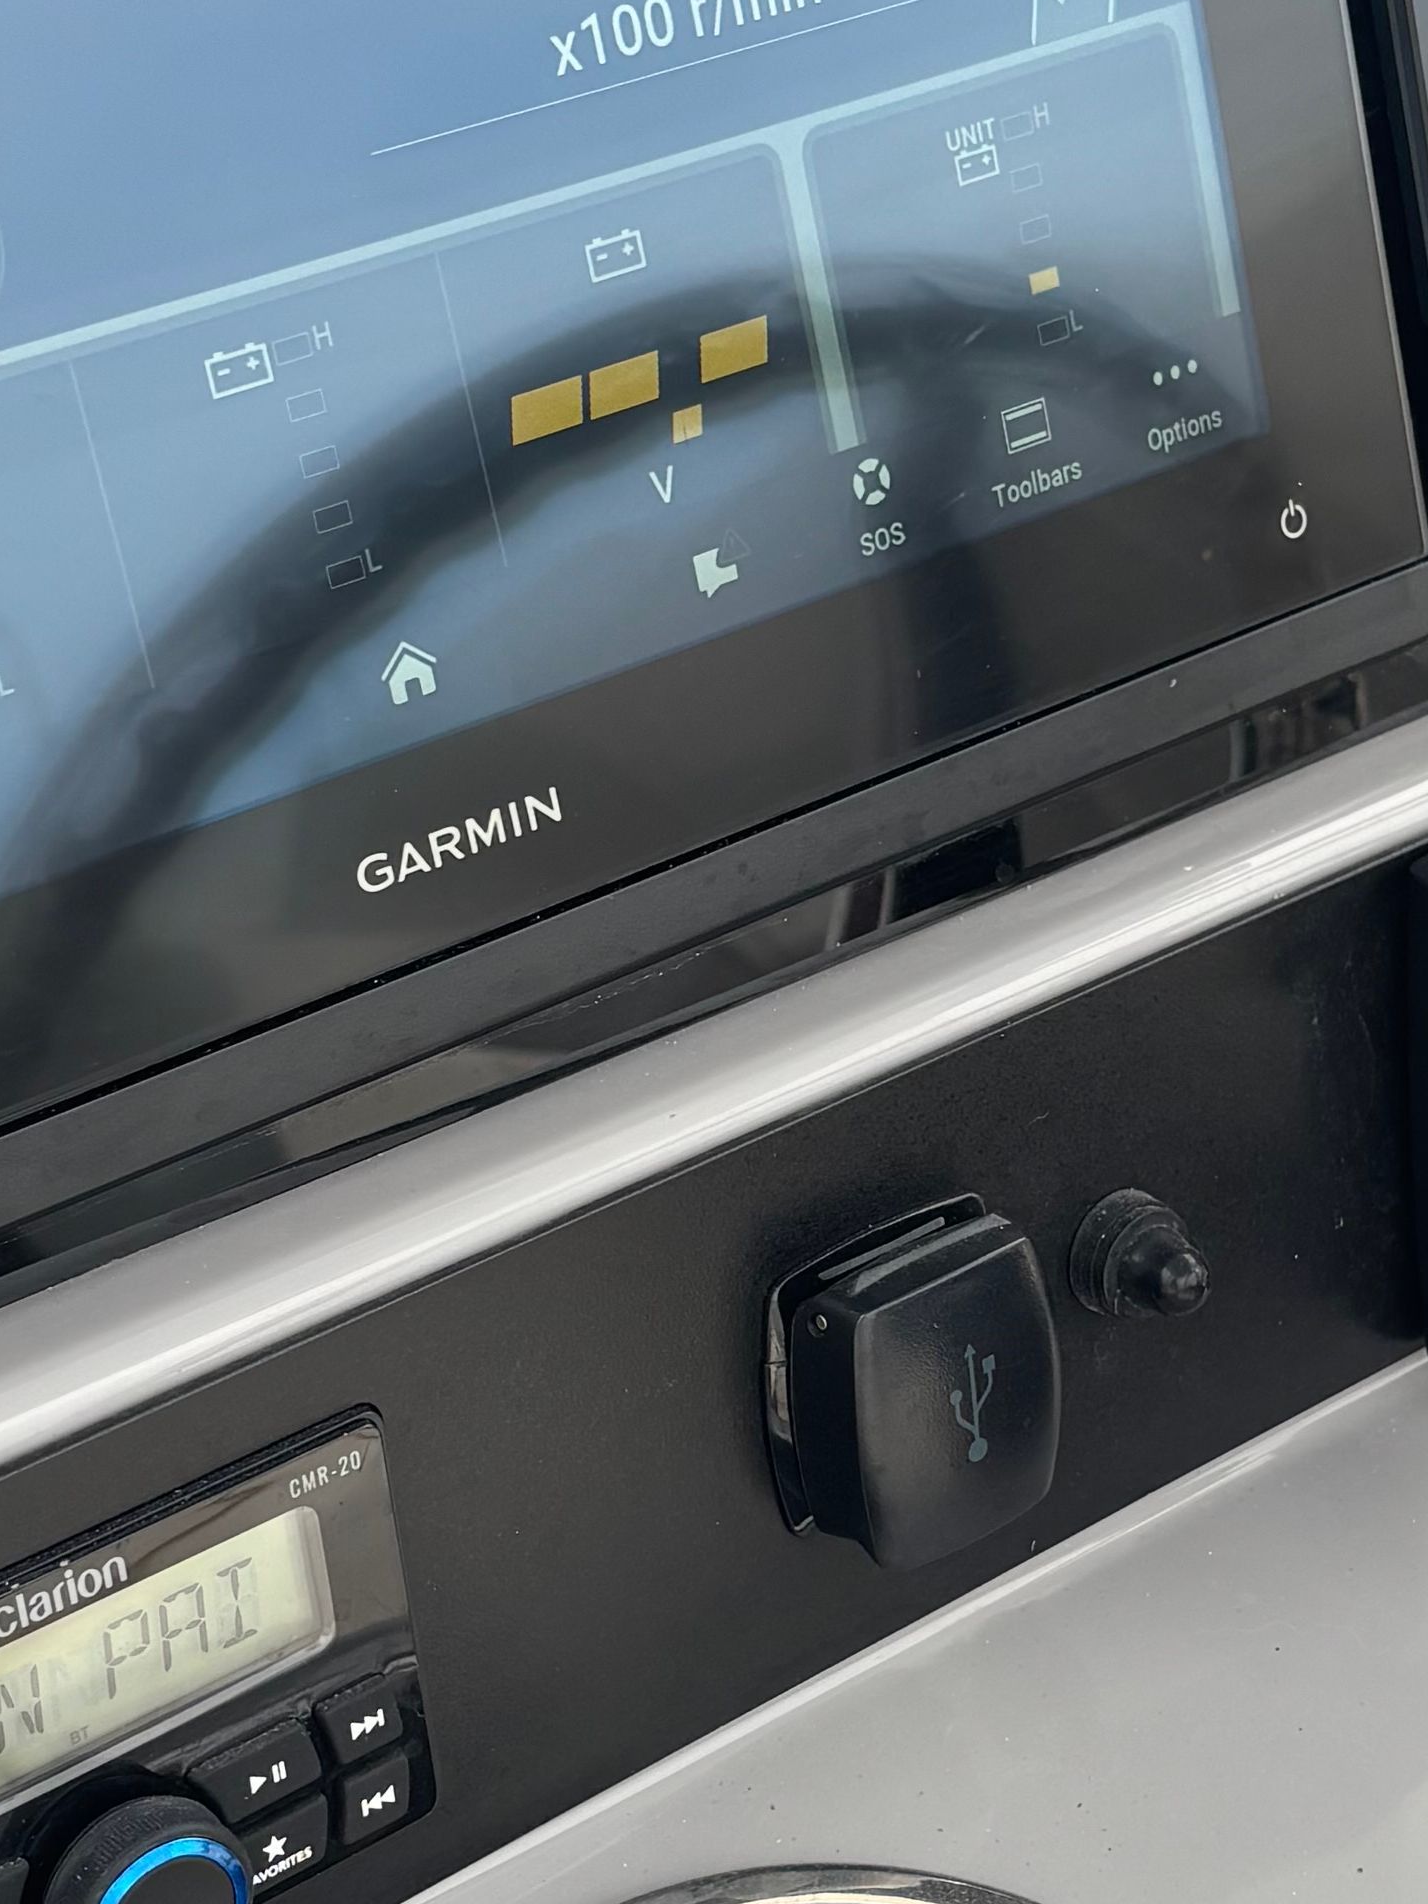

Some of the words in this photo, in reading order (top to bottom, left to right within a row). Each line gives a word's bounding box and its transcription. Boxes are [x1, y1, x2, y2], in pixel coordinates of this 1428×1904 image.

[945, 117, 997, 153] UNIT
[1033, 103, 1051, 130] H
[312, 322, 334, 352] H
[1147, 408, 1223, 453] Options
[649, 465, 674, 504] V
[992, 458, 1083, 509] Toolbars
[860, 522, 907, 558] SOS
[364, 548, 383, 575] L
[356, 785, 563, 894] GARMIN
[288, 1449, 363, 1501] CMR-20
[252, 1845, 314, 1887] AVORITES
